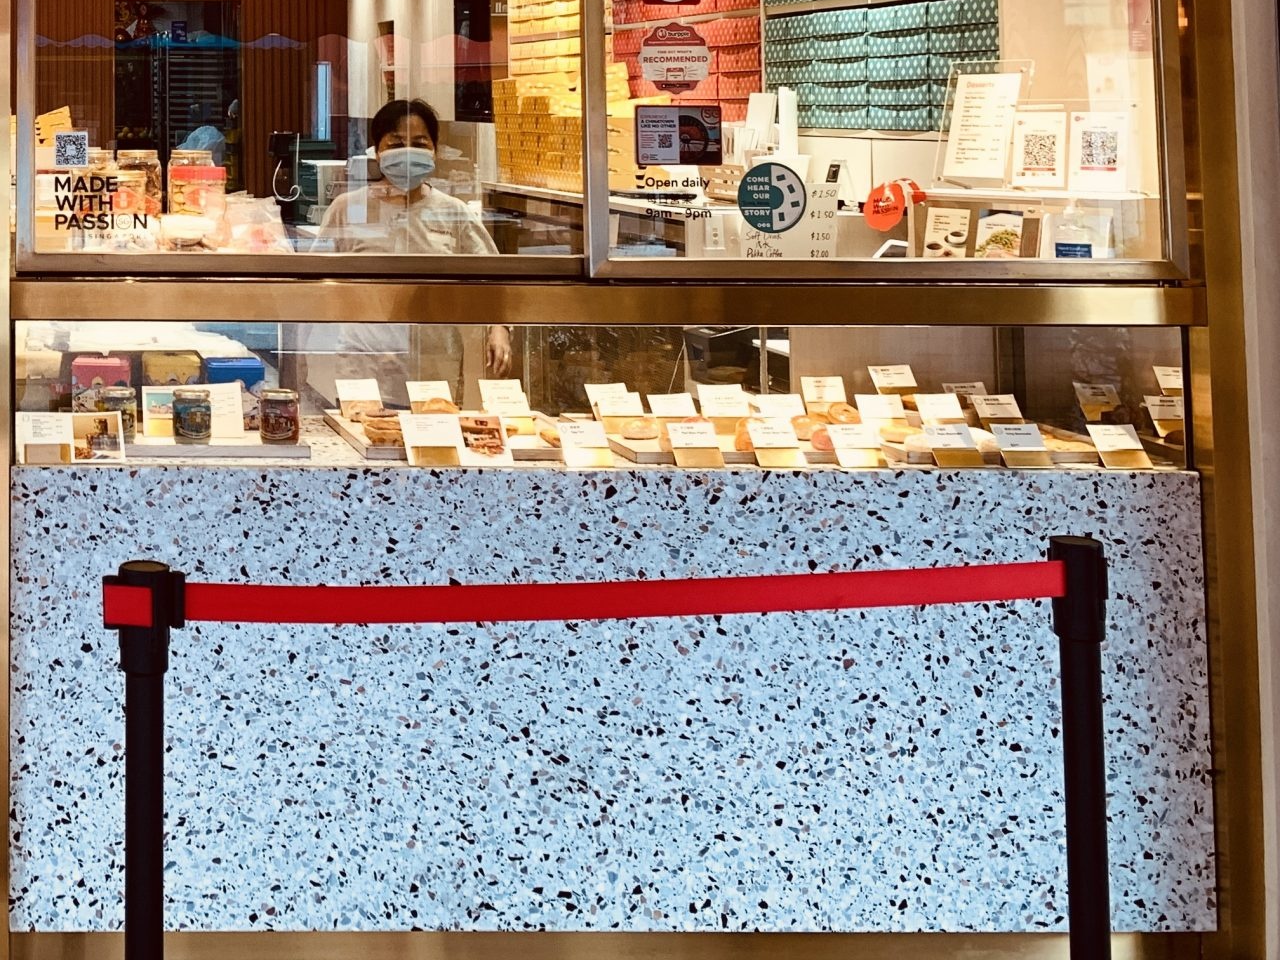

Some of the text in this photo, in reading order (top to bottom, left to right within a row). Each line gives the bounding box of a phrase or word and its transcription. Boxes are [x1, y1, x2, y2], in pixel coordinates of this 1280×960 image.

[55, 176, 118, 192] MADE
[645, 176, 710, 190] Open daily
[55, 195, 113, 211] WITH
[55, 214, 147, 230] PASSION
[646, 208, 672, 219] 9am
[685, 208, 712, 222] 9pm
